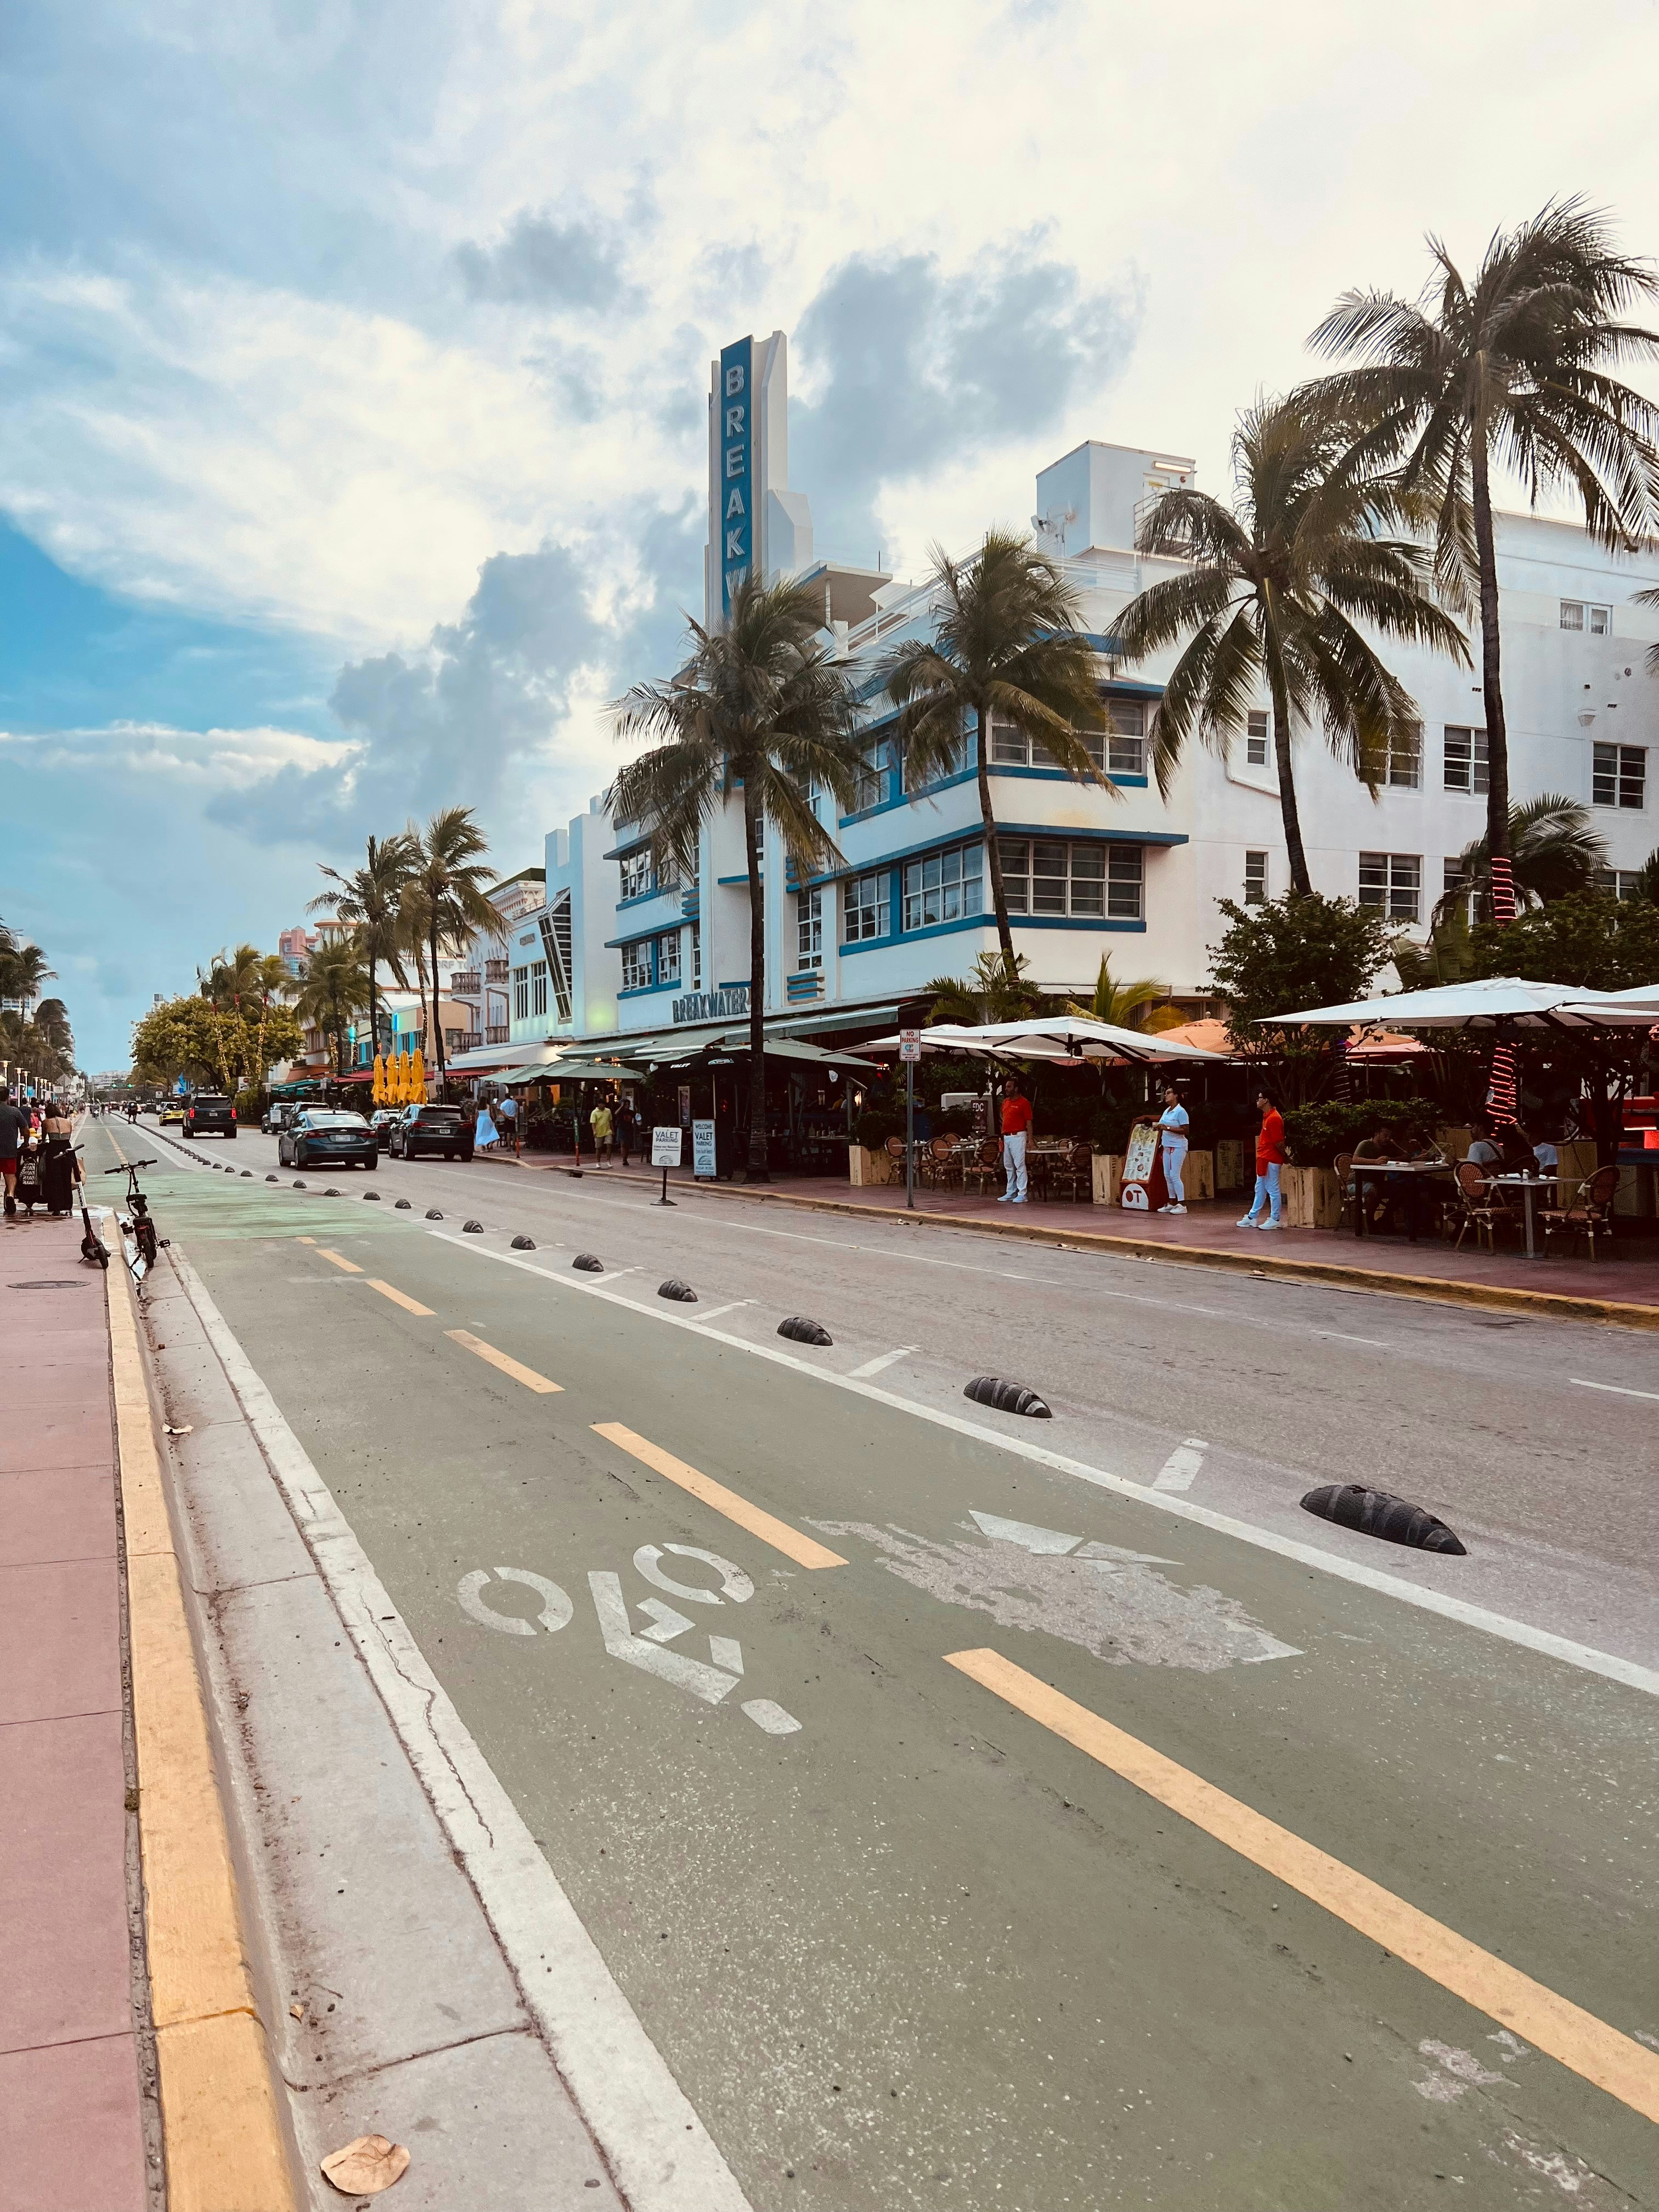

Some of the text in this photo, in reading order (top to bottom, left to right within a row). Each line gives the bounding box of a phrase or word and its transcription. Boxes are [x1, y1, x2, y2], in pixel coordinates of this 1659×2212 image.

[673, 988, 748, 1023] BREAKWATER
[695, 1132, 713, 1141] VALET
[1125, 1189, 1142, 1203] OT
